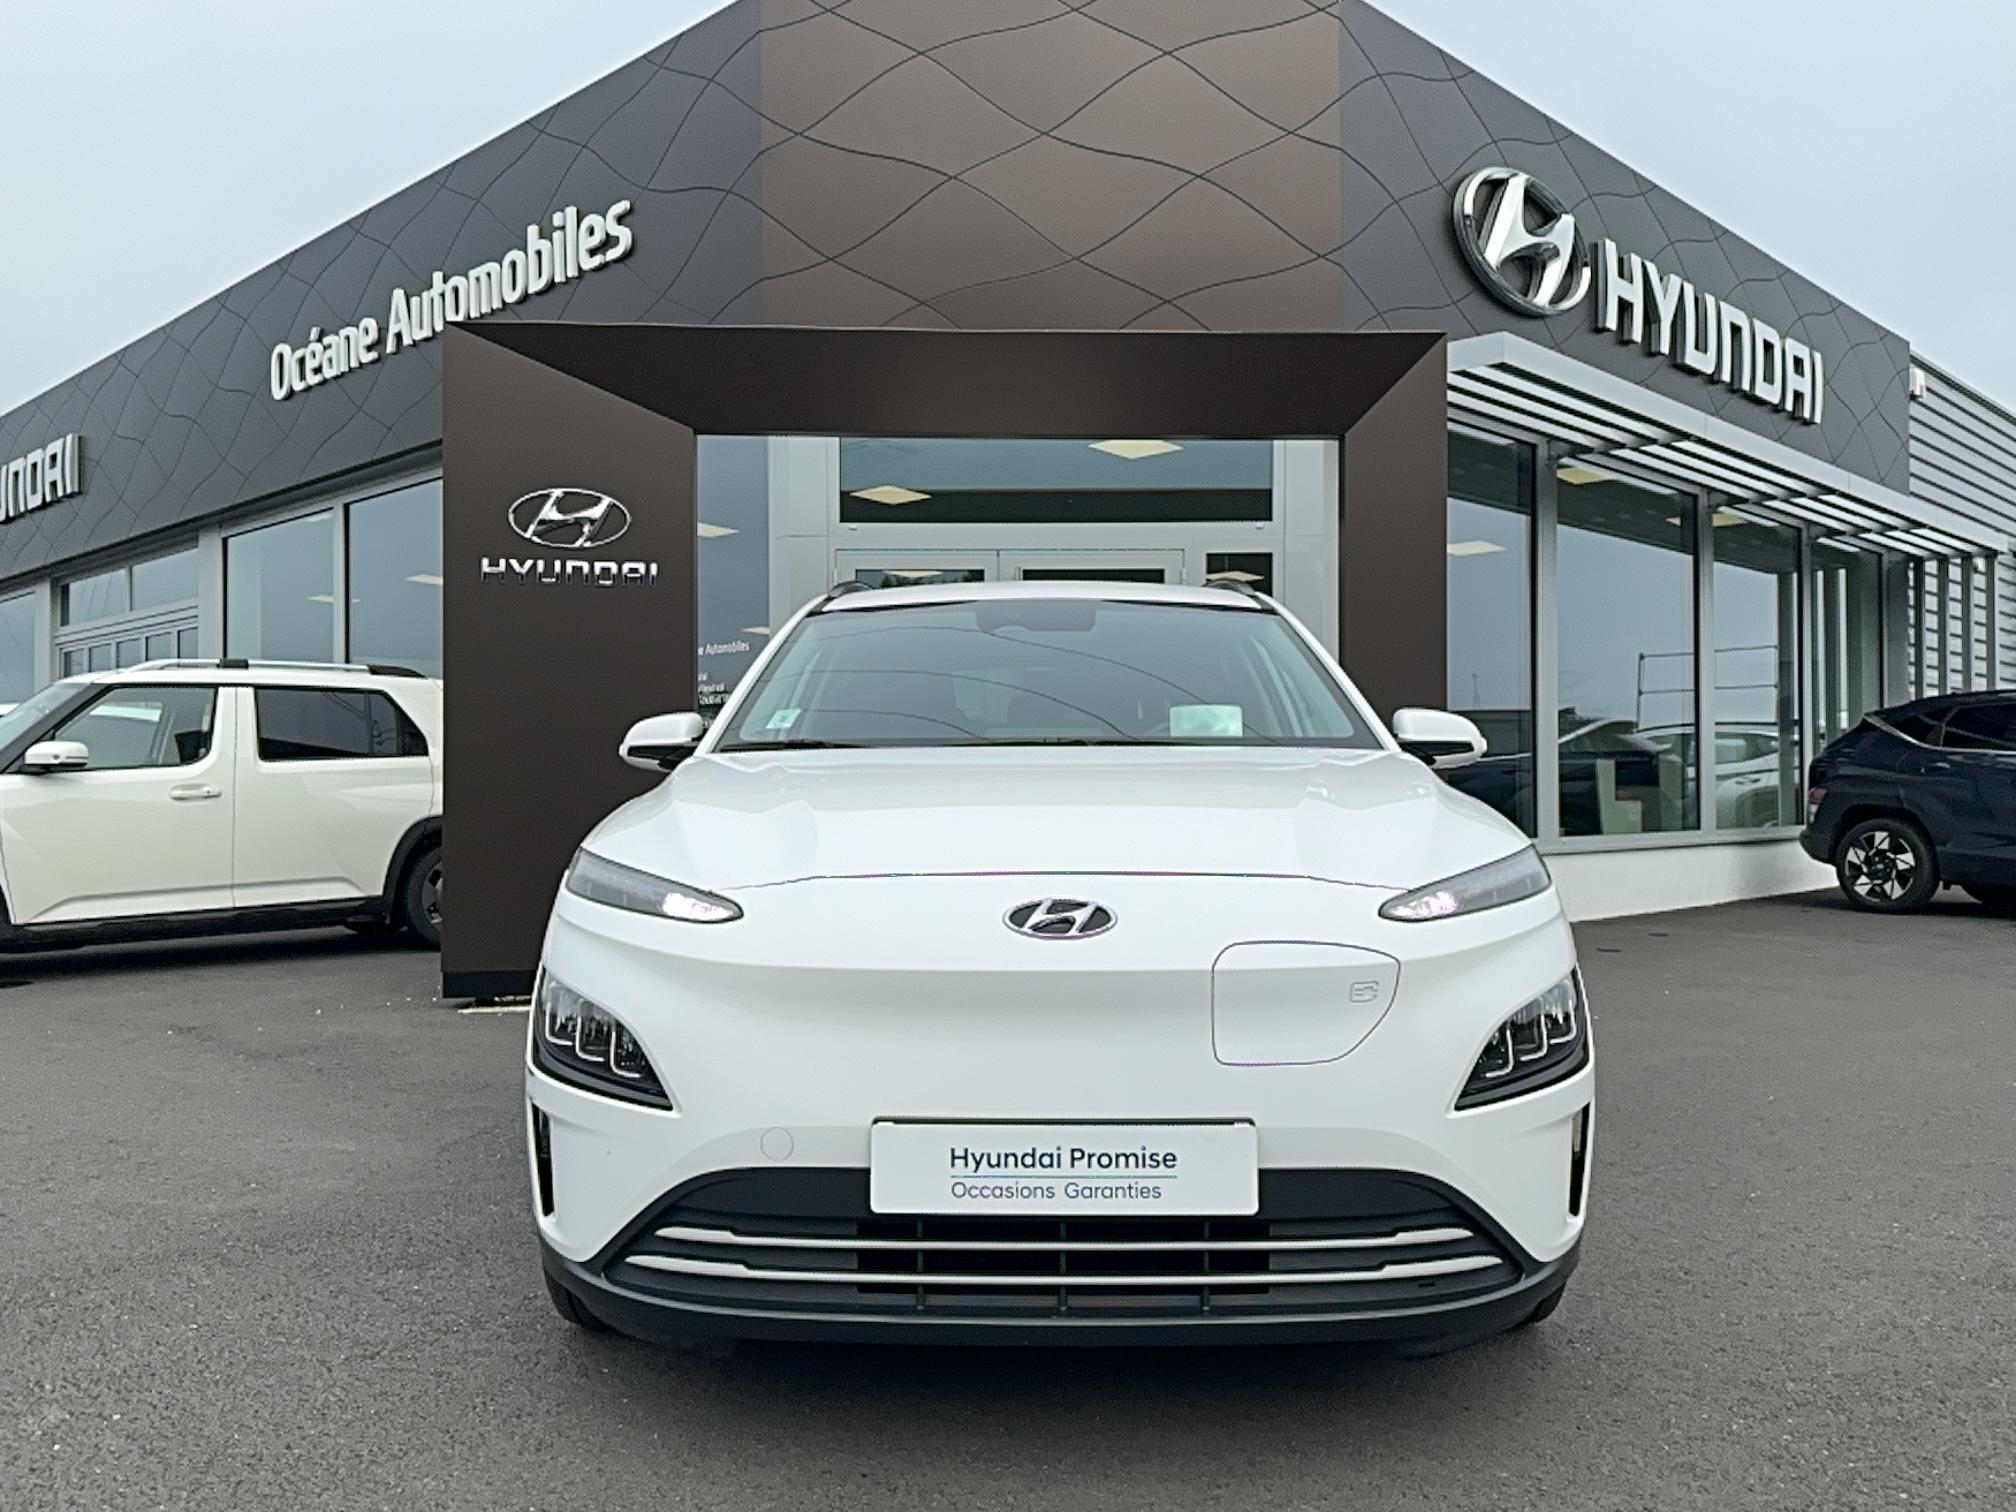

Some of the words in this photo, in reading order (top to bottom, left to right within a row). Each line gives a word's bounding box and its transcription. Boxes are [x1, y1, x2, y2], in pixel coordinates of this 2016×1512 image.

[271, 317, 379, 401] Océane
[386, 200, 633, 354] Automobiles
[1595, 238, 1825, 425] HYUNDAI
[481, 557, 658, 587] HYUNDAI
[949, 1147, 1063, 1173] Hyundai
[1069, 1146, 1178, 1169] Promise
[951, 1181, 1056, 1200] Occasions
[1063, 1181, 1163, 1200] Garanties
